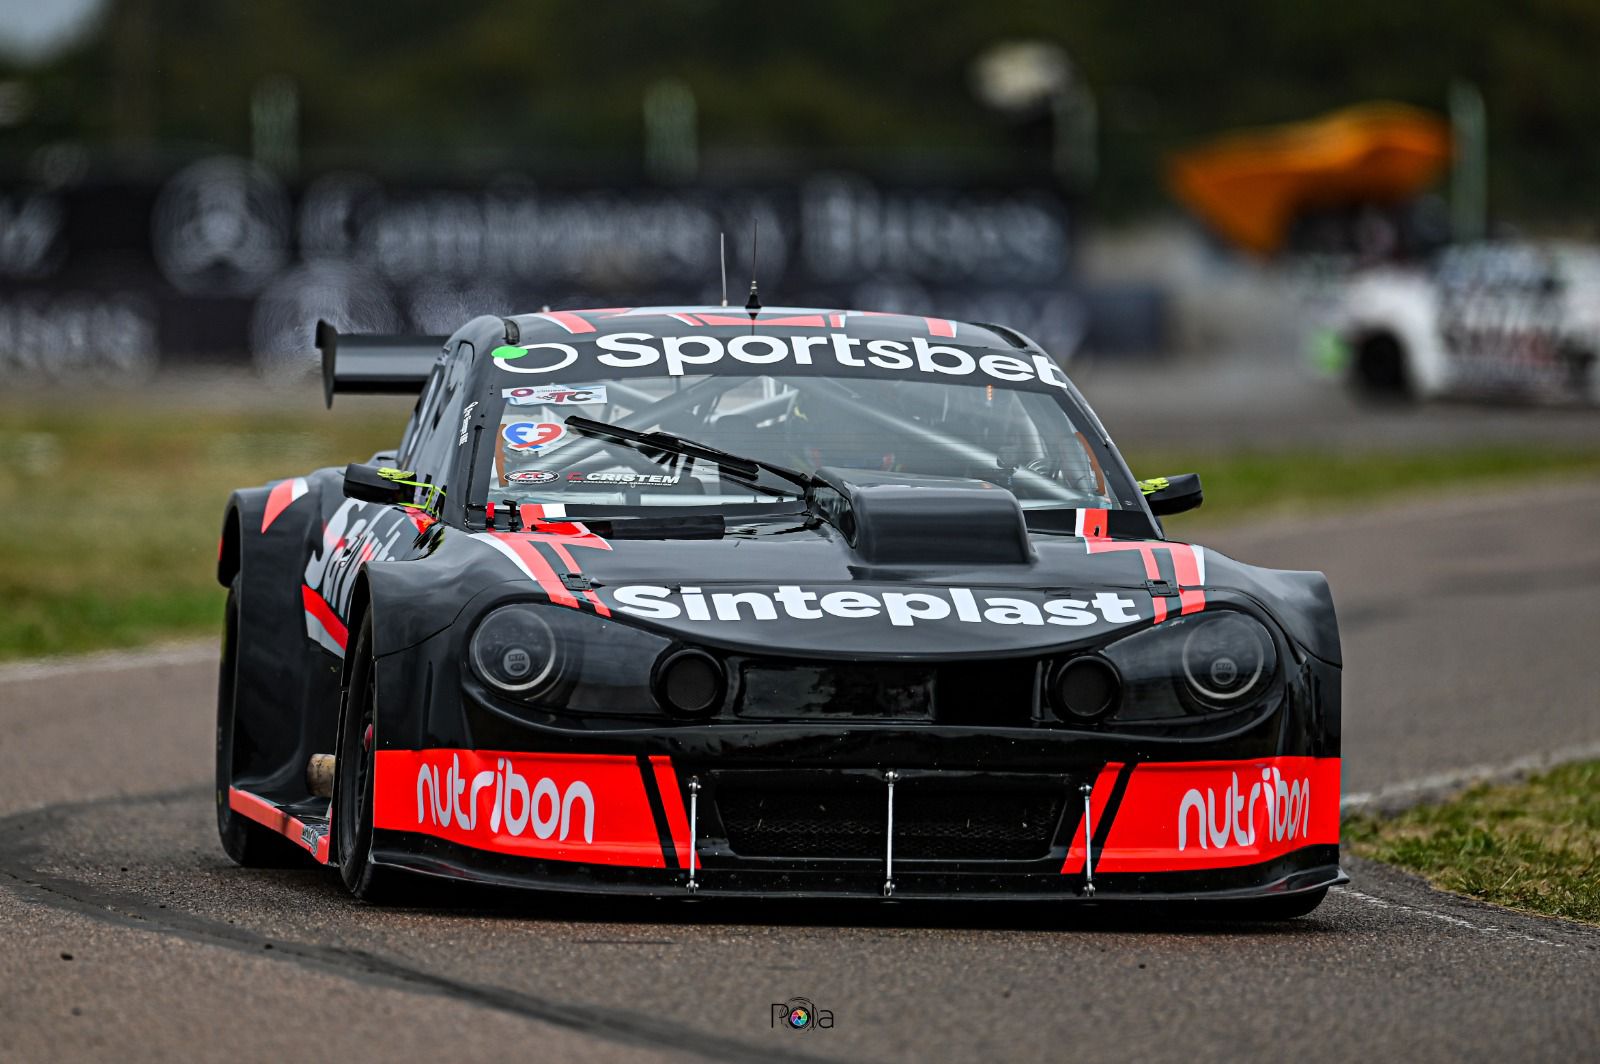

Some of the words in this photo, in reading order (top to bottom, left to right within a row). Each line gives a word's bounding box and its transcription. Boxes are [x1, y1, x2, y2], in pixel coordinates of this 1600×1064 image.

[595, 332, 1067, 390] Sportsbet
[586, 472, 680, 484] CRISTEM
[612, 584, 1142, 628] Sinteplast
[416, 752, 595, 845] nutribon
[1177, 766, 1310, 852] nutribon
